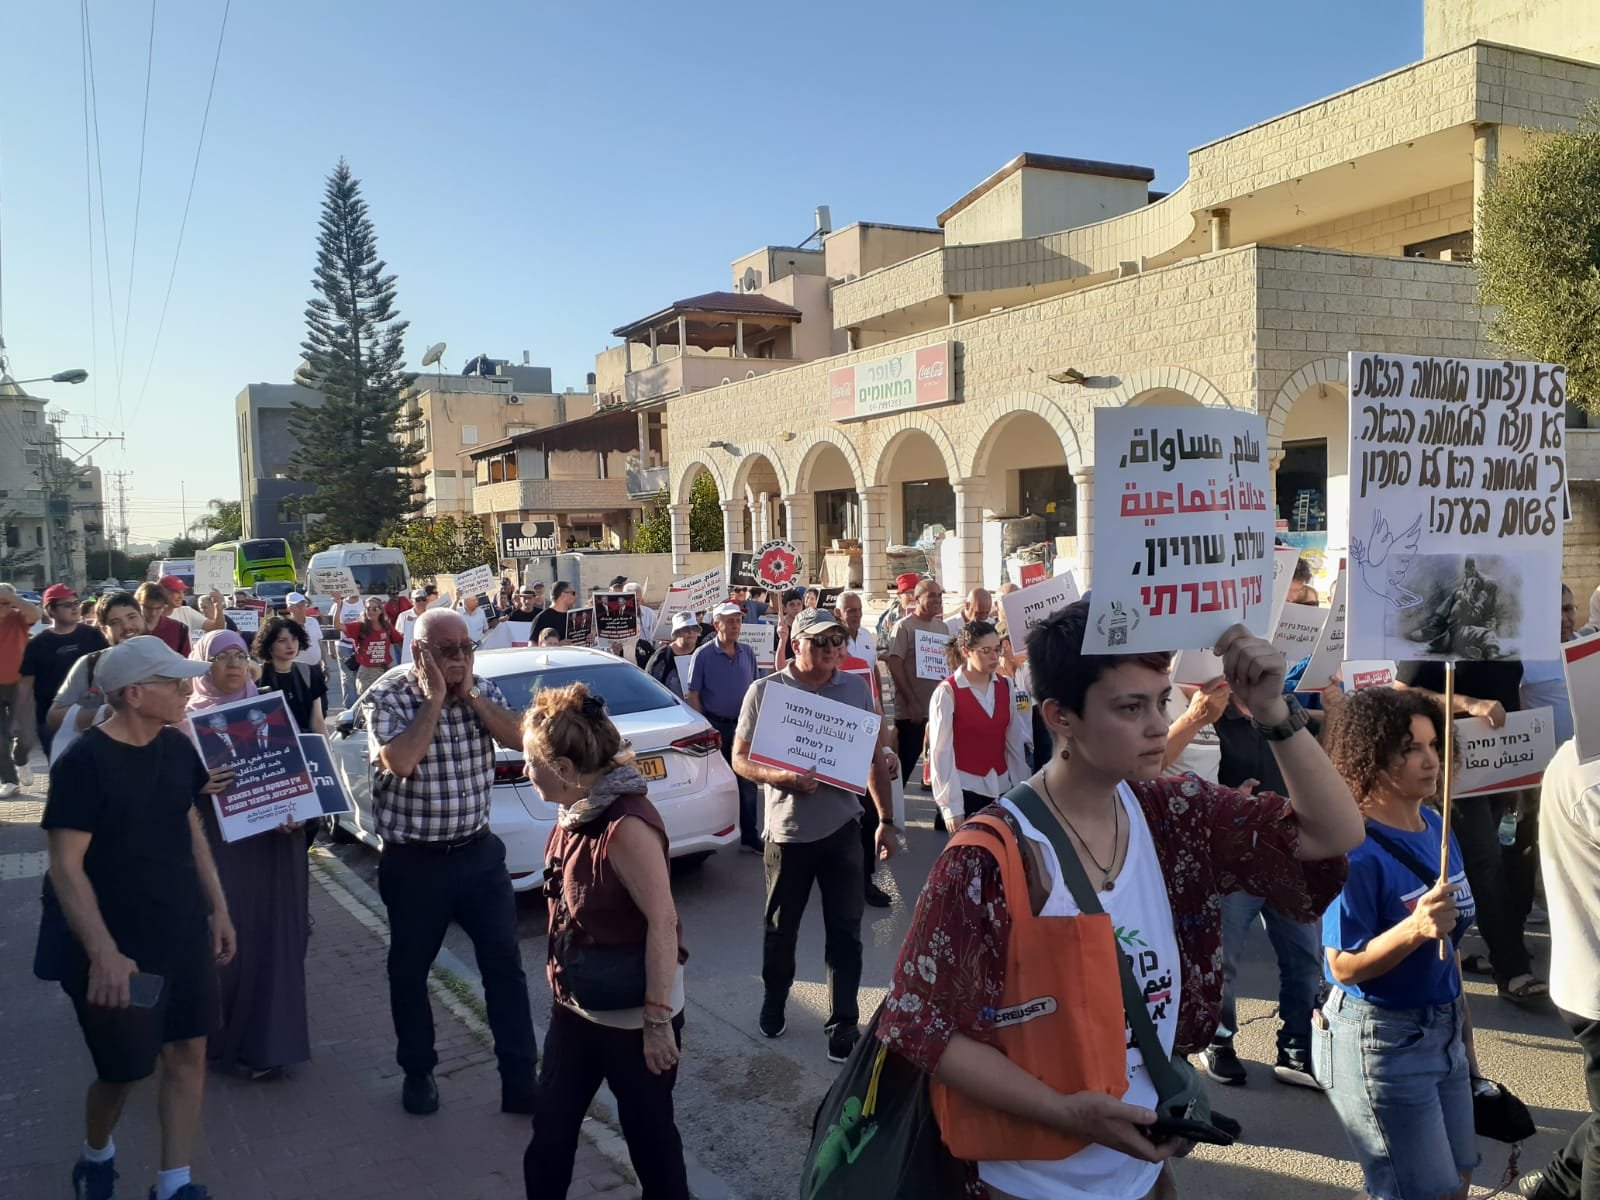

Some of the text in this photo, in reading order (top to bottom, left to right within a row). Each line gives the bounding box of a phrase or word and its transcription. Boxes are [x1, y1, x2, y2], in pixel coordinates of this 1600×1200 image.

[868, 357, 902, 380] סופר
[1410, 358, 1470, 402] במלחמה
[859, 379, 911, 402] התאומים
[1477, 362, 1527, 410] ניצחנו
[1531, 365, 1565, 407] לא
[1418, 405, 1486, 446] במלחמה
[1498, 408, 1532, 454] ננצח
[1540, 411, 1564, 448] לא
[1360, 447, 1565, 498] כי מלחמה היא לא פתרון
[1239, 480, 1266, 511] عدالة
[1429, 496, 1557, 538] לשום בעיה!
[757, 541, 785, 556] לכיבוש
[1132, 526, 1264, 576] שלום, שוויון,
[760, 580, 788, 590] לשלום
[1024, 593, 1065, 614] ביחד נחיה
[1140, 575, 1262, 619] צדק חברתי
[785, 702, 812, 716] ולמצור
[815, 711, 844, 727] לכיבוש
[780, 714, 814, 733] والحصار
[846, 721, 857, 730] לא
[796, 735, 833, 753] כן לשלום
[848, 733, 854, 743] لا
[1467, 733, 1530, 750] ביחד נחיה
[787, 746, 836, 767] نعم للسلام
[1494, 749, 1534, 769] نعيش
[993, 1001, 1048, 1025] CREUSET
